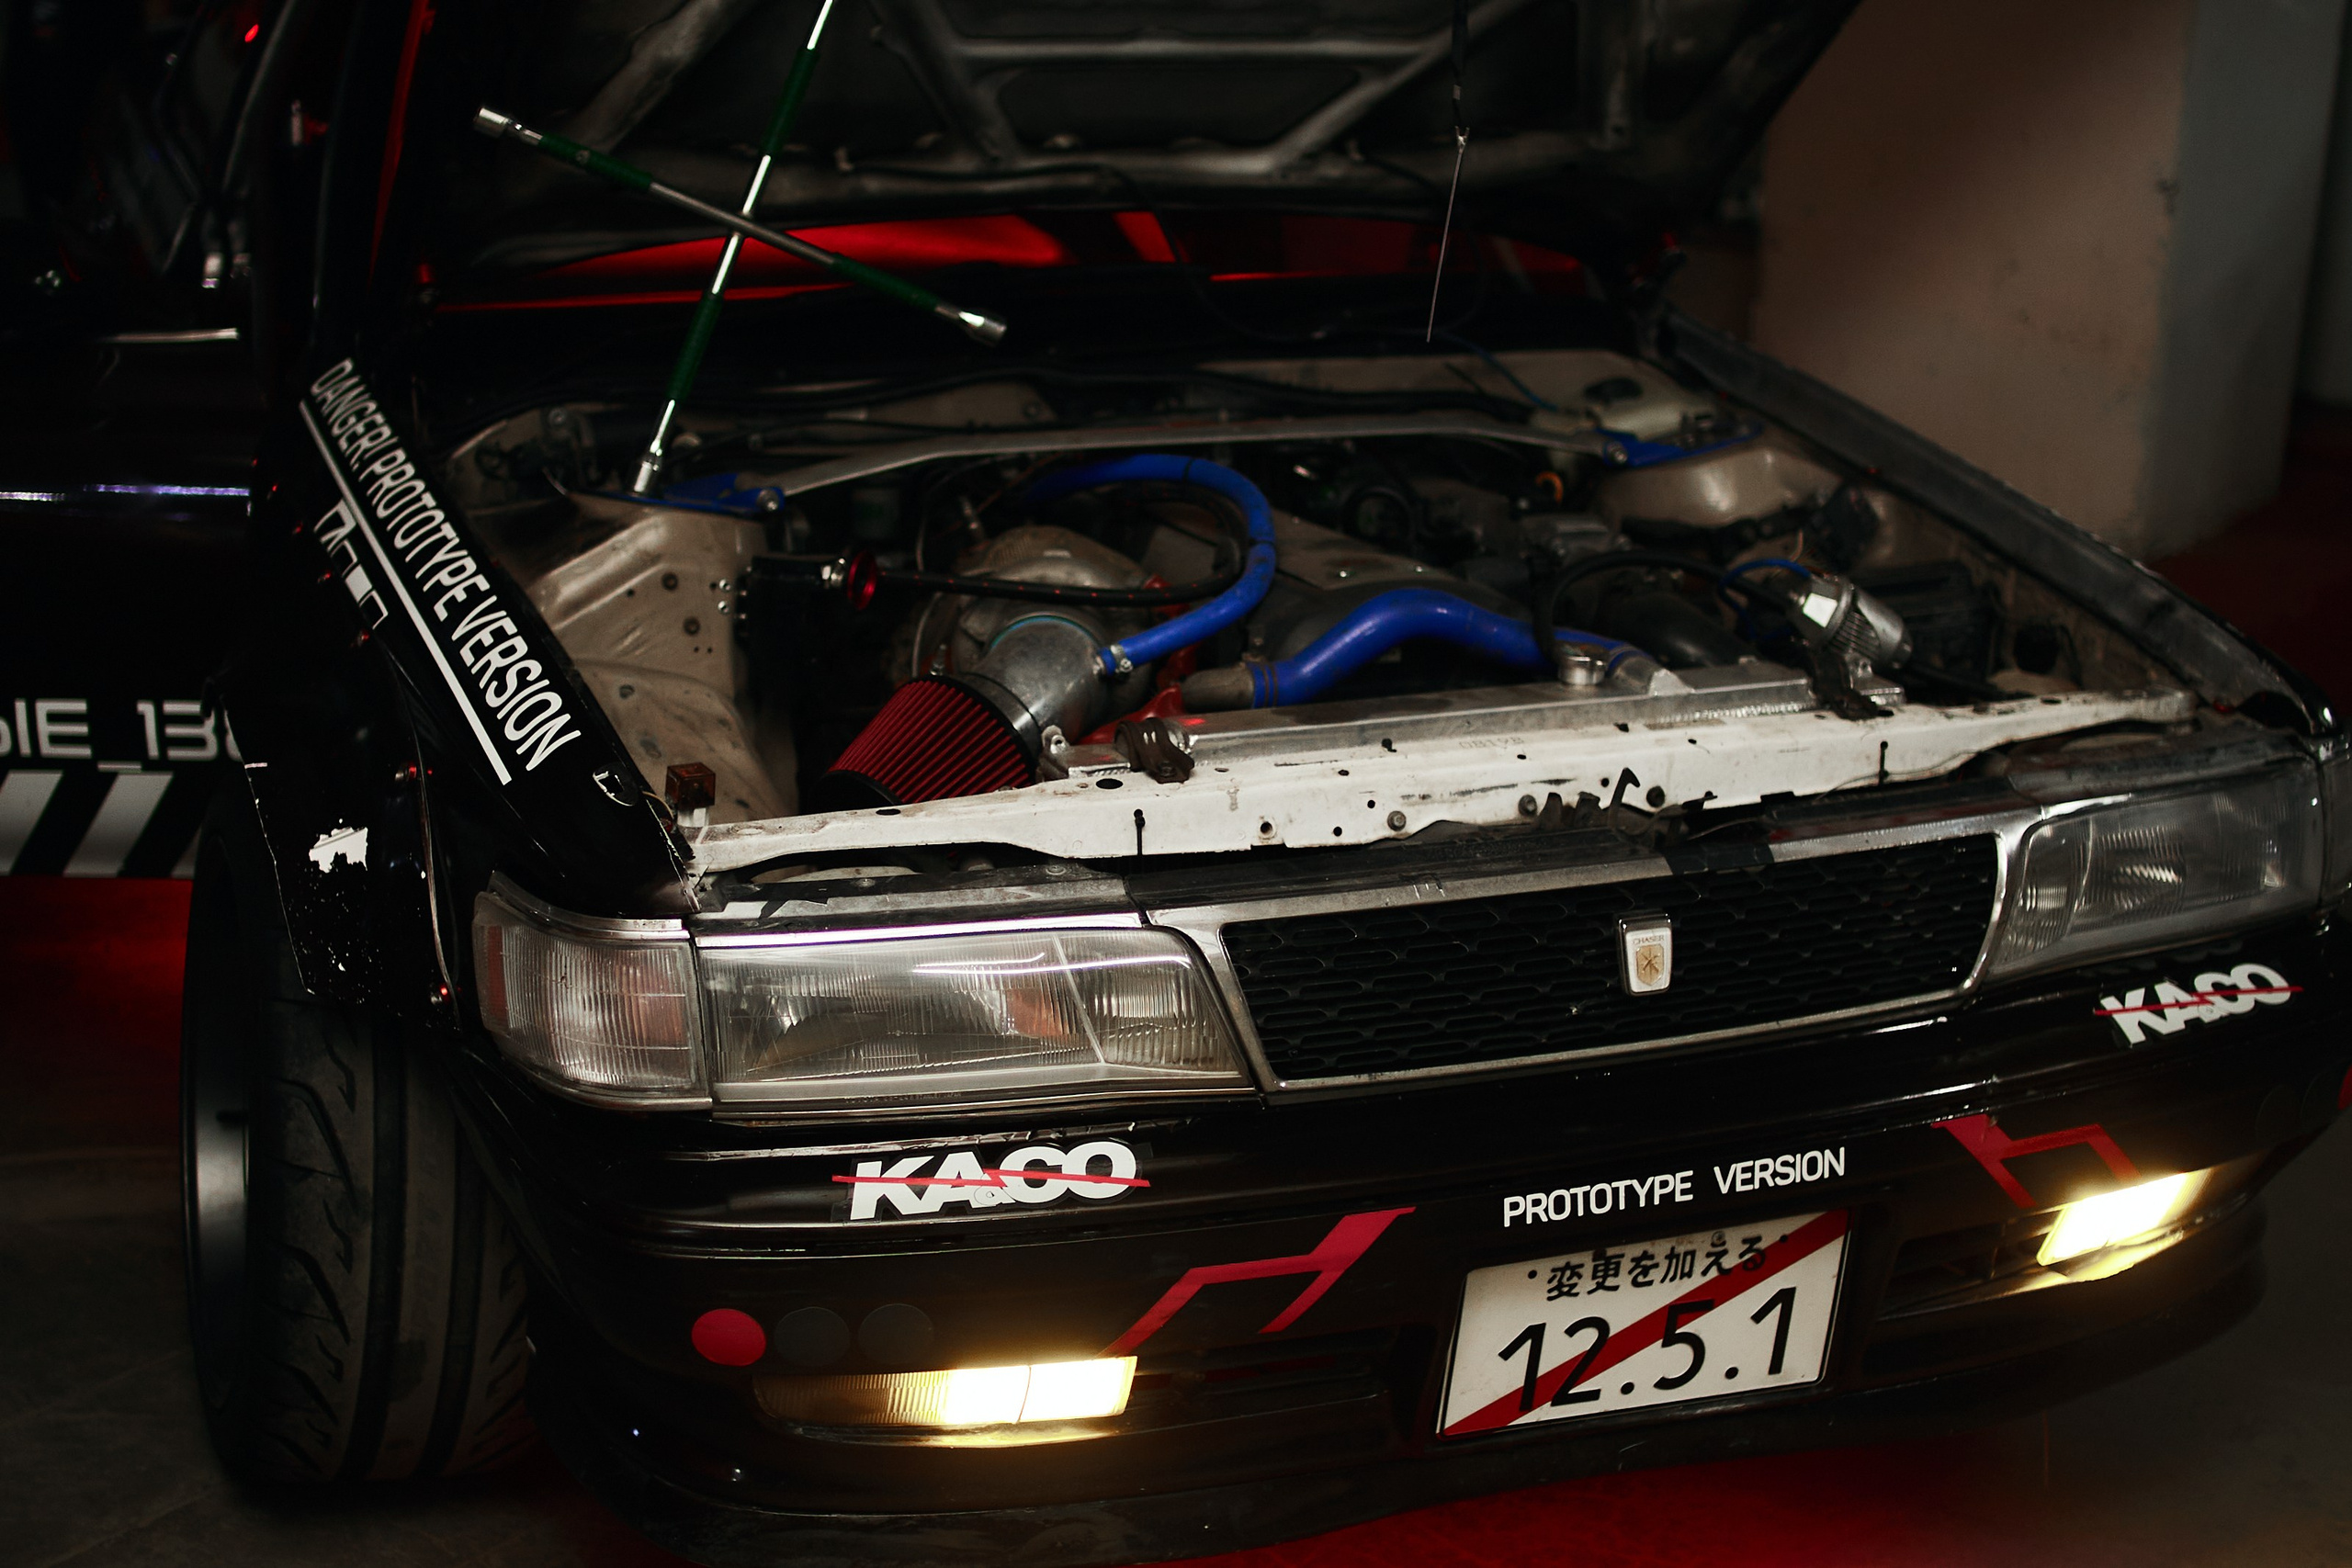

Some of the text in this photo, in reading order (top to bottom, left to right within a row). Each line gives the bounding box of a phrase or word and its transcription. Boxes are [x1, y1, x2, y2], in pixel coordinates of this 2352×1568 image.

[310, 356, 401, 473] DANGER!
[358, 446, 491, 623] PROTOTYPE
[451, 594, 582, 772] VERSION
[1633, 934, 1665, 945] CHASER
[1503, 1145, 1846, 1228] PROTOTYPE VERSION
[1546, 1235, 1767, 1302] 変更を加える
[1498, 1286, 1797, 1412] 12.5.1
